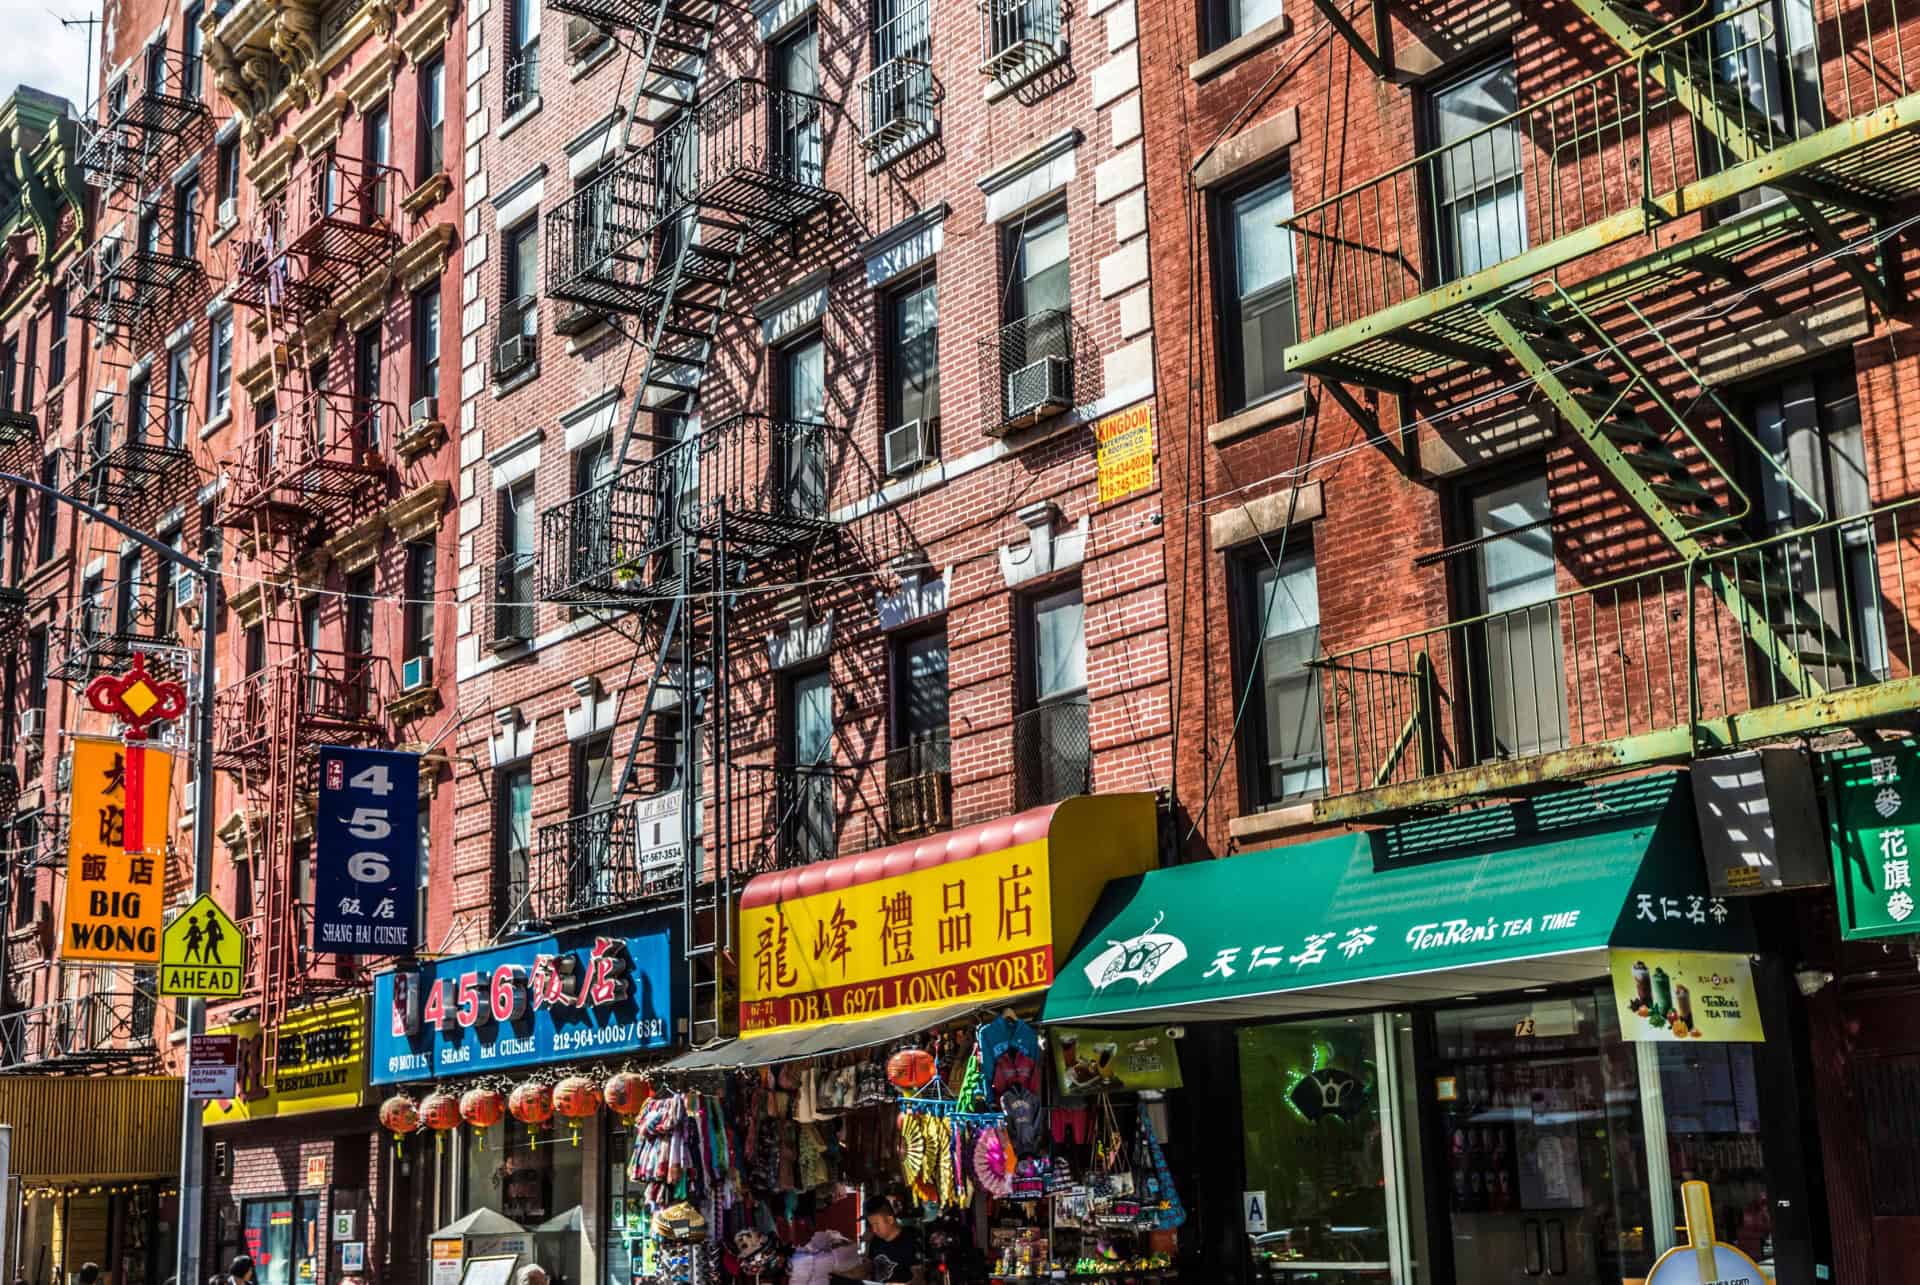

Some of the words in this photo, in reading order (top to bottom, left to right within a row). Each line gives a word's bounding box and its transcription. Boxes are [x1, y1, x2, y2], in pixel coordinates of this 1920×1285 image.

[1097, 407, 1148, 442] KINGDOM
[81, 853, 154, 886] 飯店
[89, 890, 141, 919] BIG
[322, 923, 352, 942] SHANG
[356, 925, 371, 943] HAI
[374, 926, 408, 945] CUISINE
[1501, 918, 1533, 938] TEA
[1540, 910, 1581, 931] TIME
[71, 923, 156, 953] WONG
[169, 971, 233, 990] AHEAD
[789, 995, 833, 1025] DBA
[844, 987, 885, 1016] 6971
[893, 969, 957, 1007] LONG
[967, 951, 1048, 994] STORE
[1516, 1019, 1535, 1035] 73
[441, 1046, 470, 1065] SHANG
[500, 1036, 536, 1058] CUISINE
[276, 1069, 348, 1094] RESTAURANT
[309, 1158, 326, 1173] ATM
[1248, 1197, 1263, 1221] A
[338, 1218, 349, 1234] B
